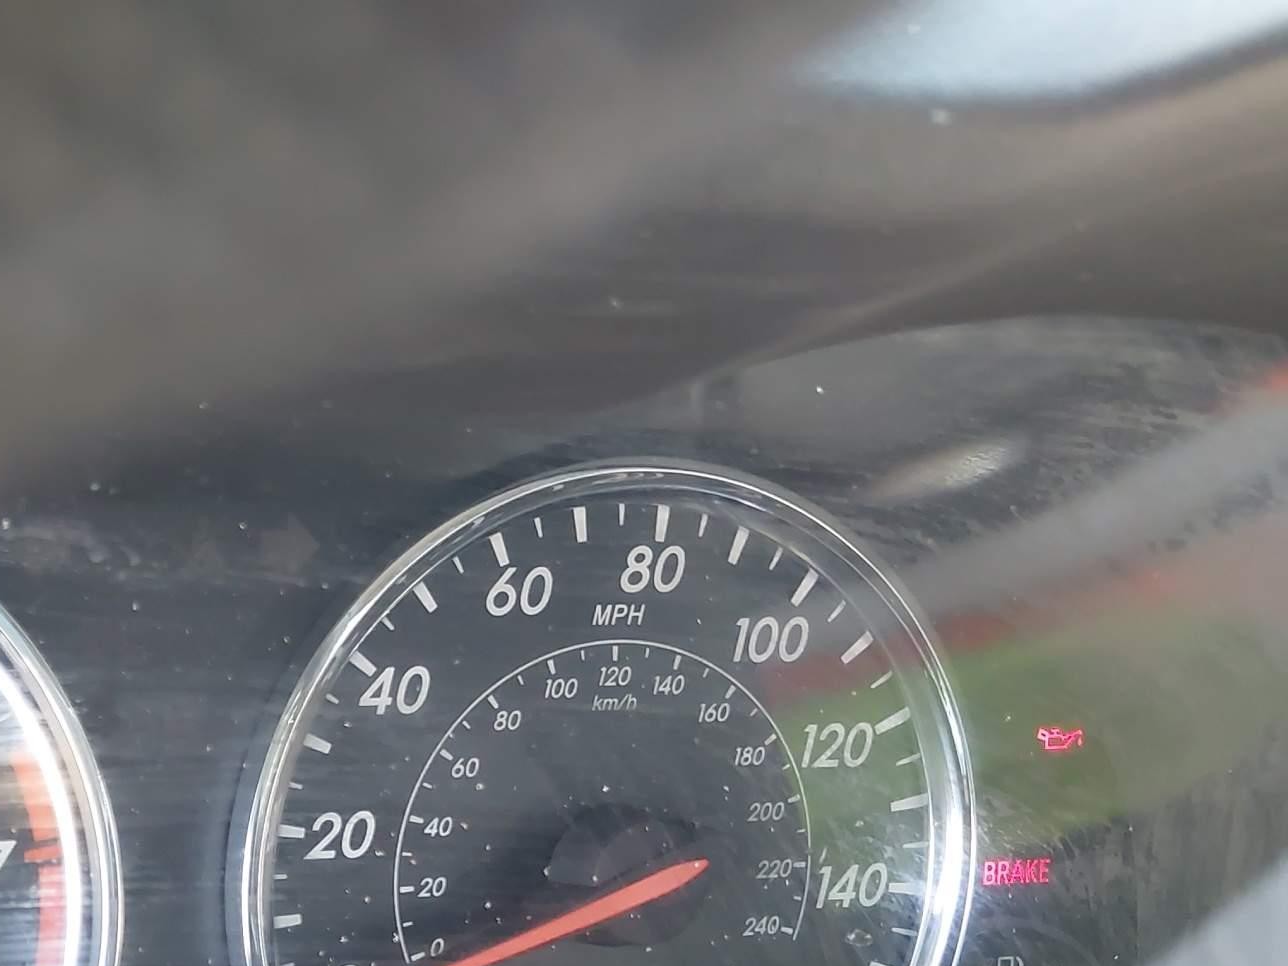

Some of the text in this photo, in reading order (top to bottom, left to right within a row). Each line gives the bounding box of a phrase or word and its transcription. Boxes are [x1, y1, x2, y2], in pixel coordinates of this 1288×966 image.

[619, 545, 686, 593] 80
[486, 566, 553, 616] 60
[592, 603, 645, 627] MPH
[733, 616, 810, 663] 100
[598, 666, 632, 686] 120
[653, 675, 685, 695] 140
[359, 664, 430, 713] 40
[544, 678, 578, 698] 100
[591, 694, 638, 712] km/h
[698, 703, 730, 722] 160
[493, 710, 521, 731] 80
[802, 722, 874, 768] 120
[451, 756, 480, 779] 60
[734, 747, 766, 766] 180
[748, 801, 785, 821] 200
[304, 810, 376, 860] 20
[423, 815, 453, 837] 40
[756, 860, 792, 879] 220
[982, 858, 1051, 886] BRAKE
[418, 875, 447, 898] 20
[814, 862, 890, 909] 140
[743, 917, 780, 936] 240
[430, 937, 445, 957] 0
